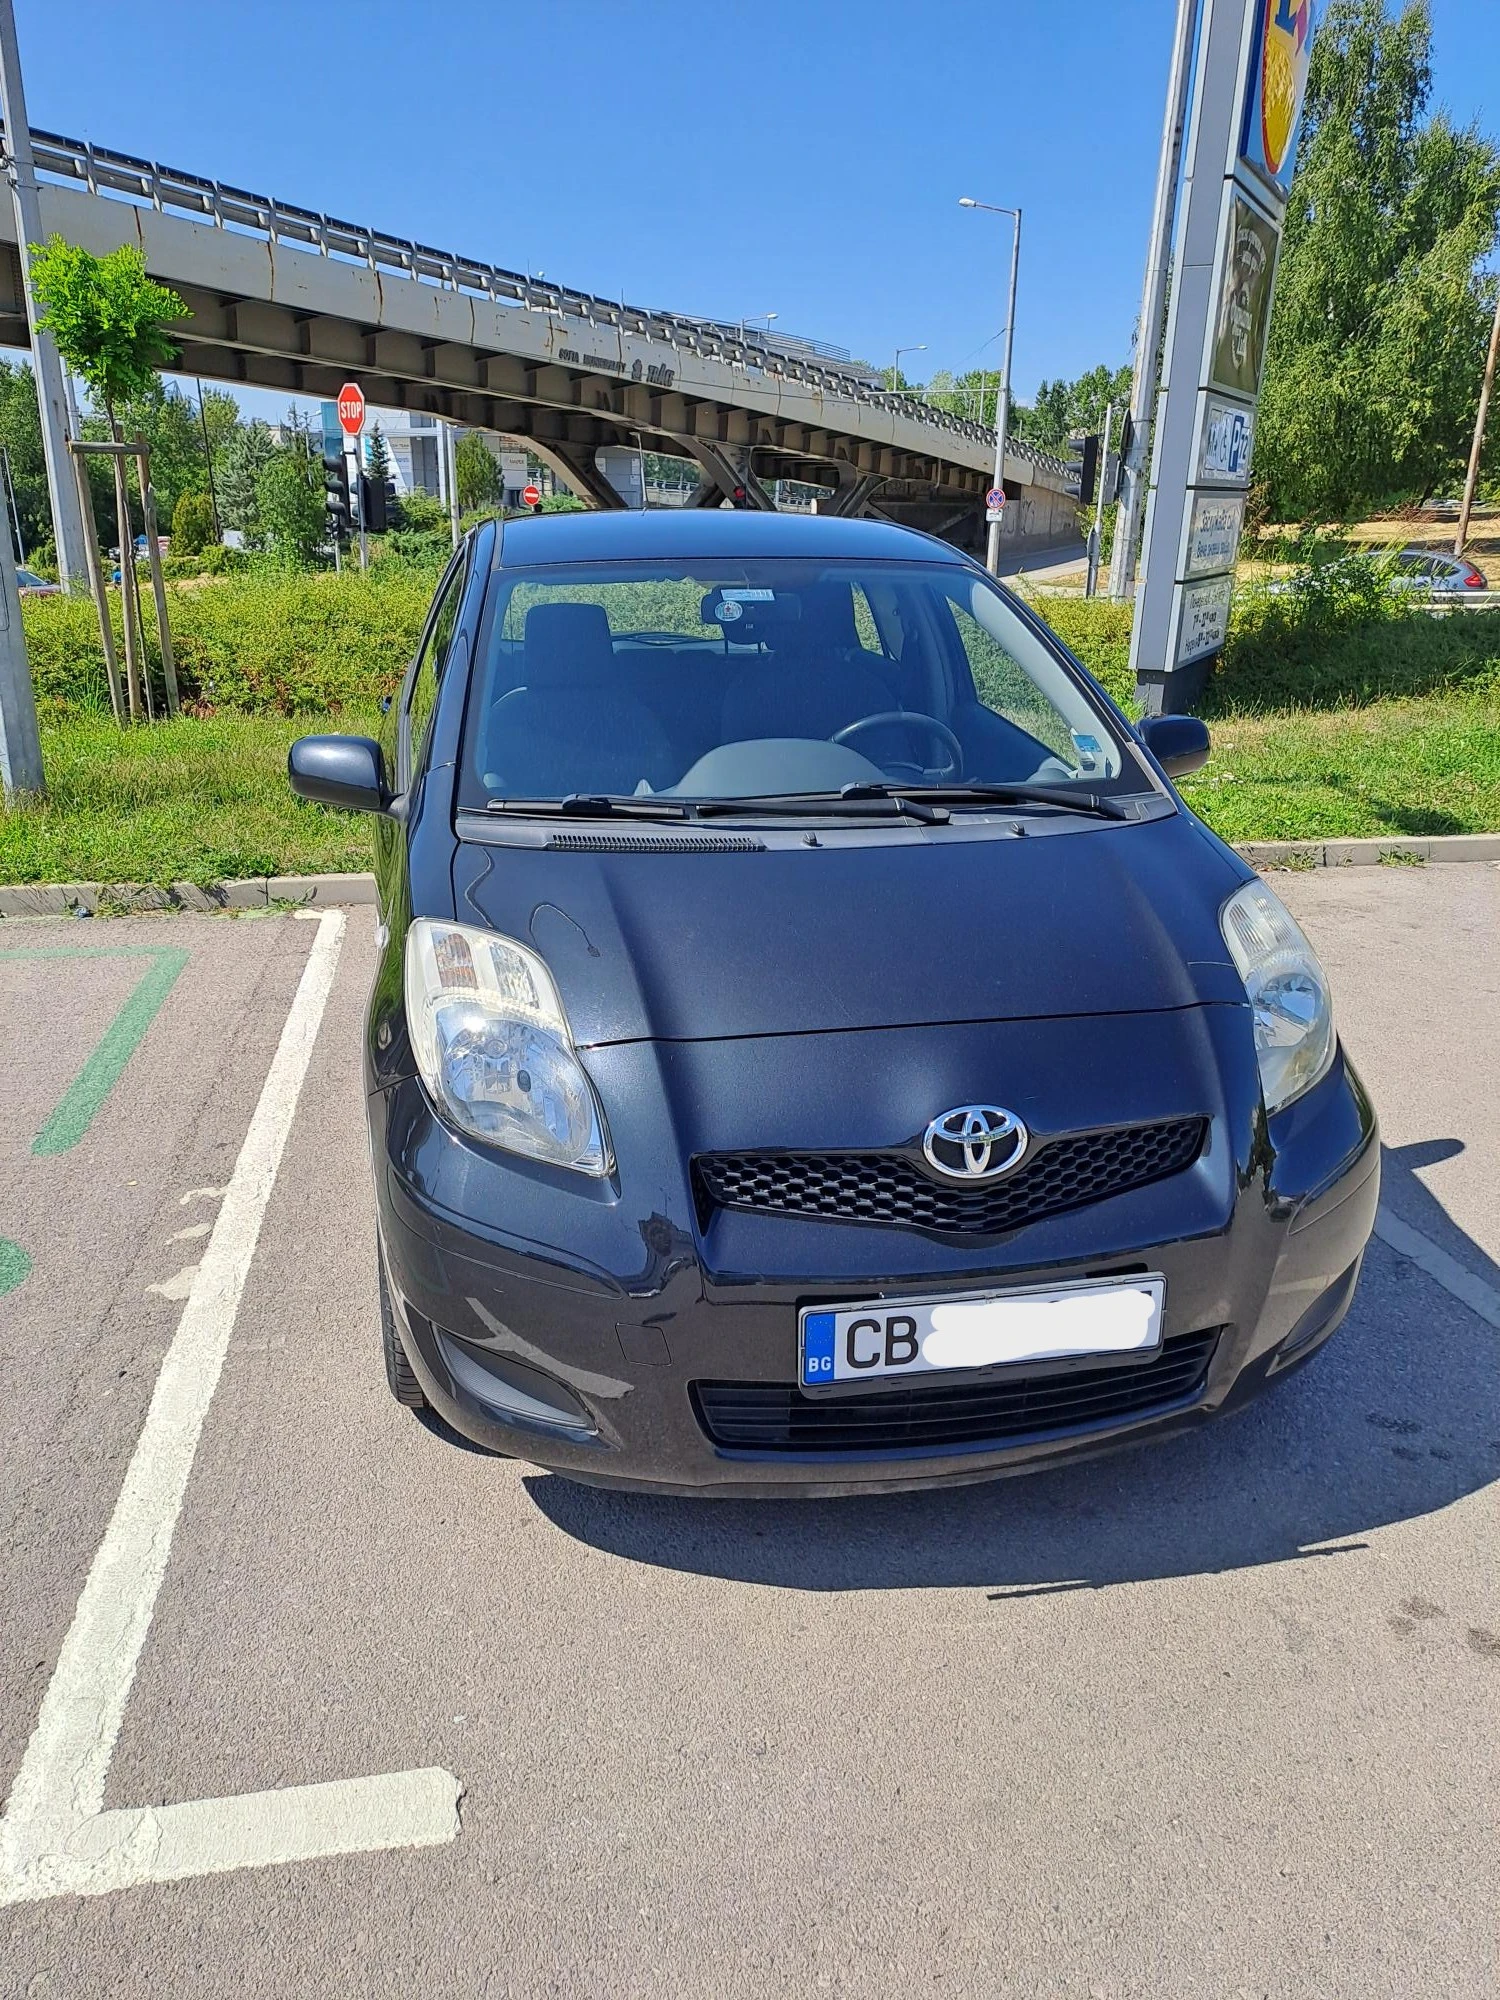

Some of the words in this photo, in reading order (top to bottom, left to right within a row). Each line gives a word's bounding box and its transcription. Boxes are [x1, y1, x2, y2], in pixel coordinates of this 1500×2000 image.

[340, 401, 362, 419] STOP
[846, 1315, 919, 1370] CB
[808, 1356, 832, 1373] BG
